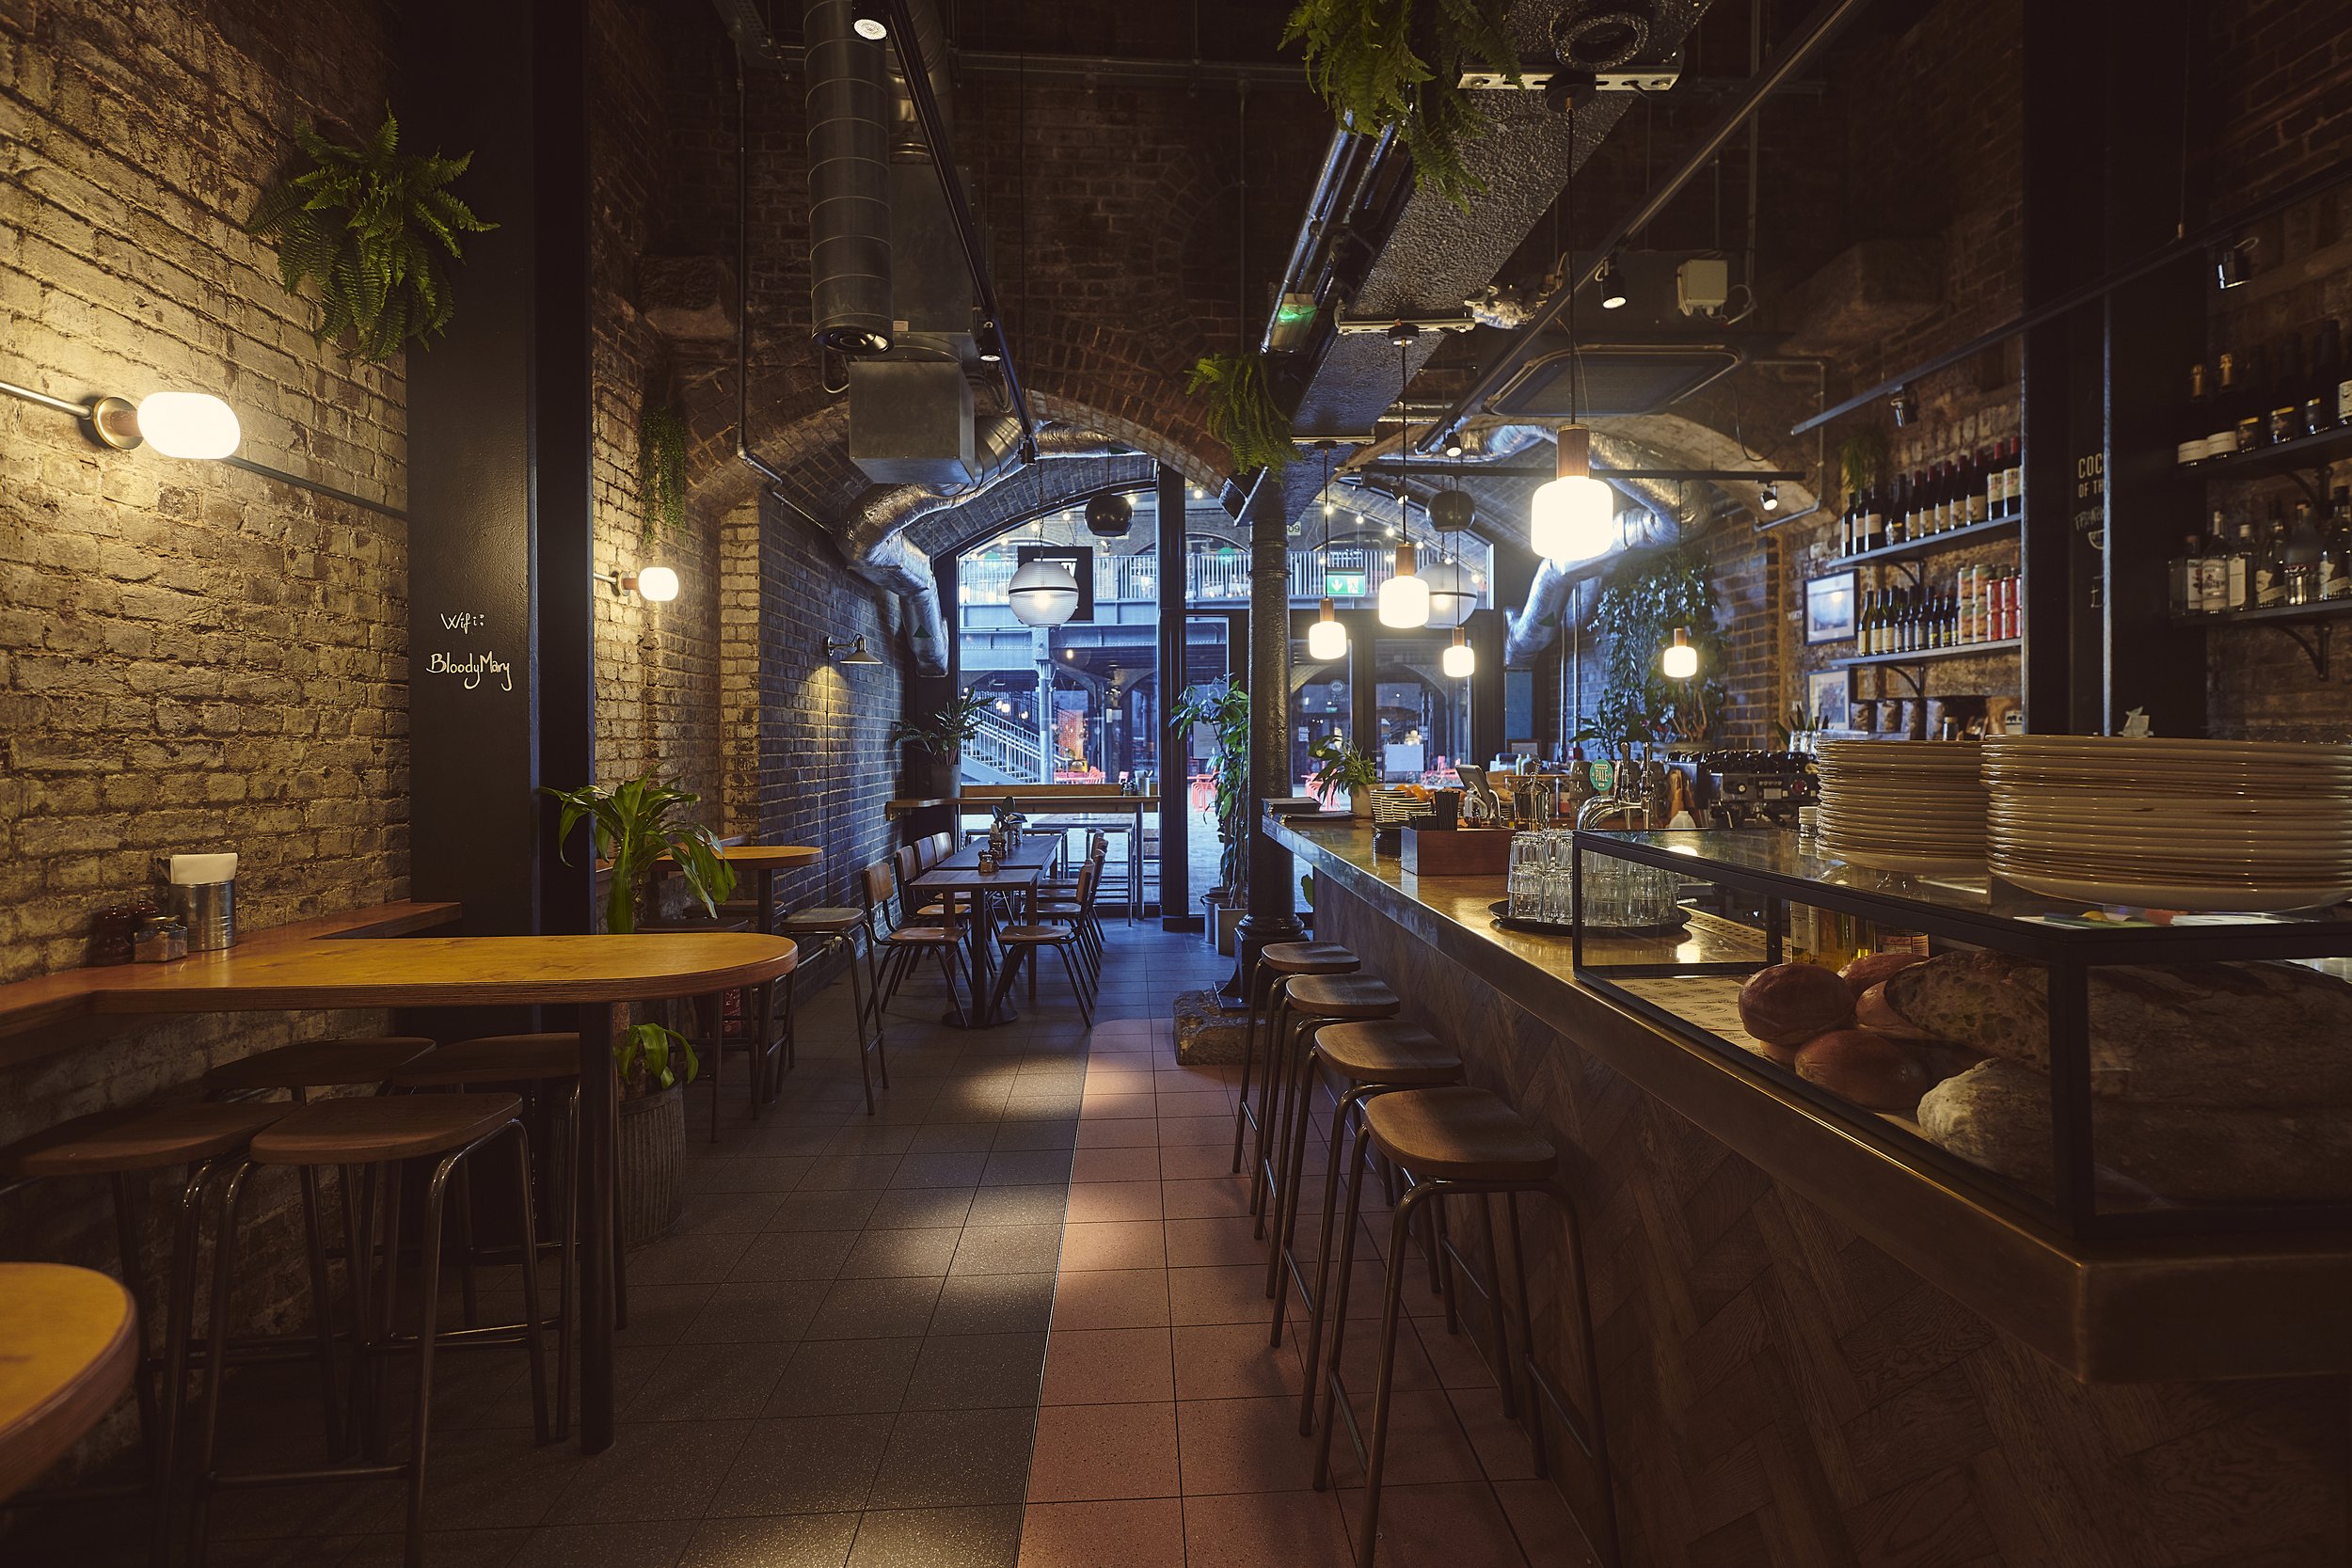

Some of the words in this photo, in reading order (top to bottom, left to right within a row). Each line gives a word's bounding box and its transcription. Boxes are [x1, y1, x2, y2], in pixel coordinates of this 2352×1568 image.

[2078, 482, 2089, 499] OF
[440, 611, 485, 635] Wifi:
[1595, 769, 1608, 783] PALE
